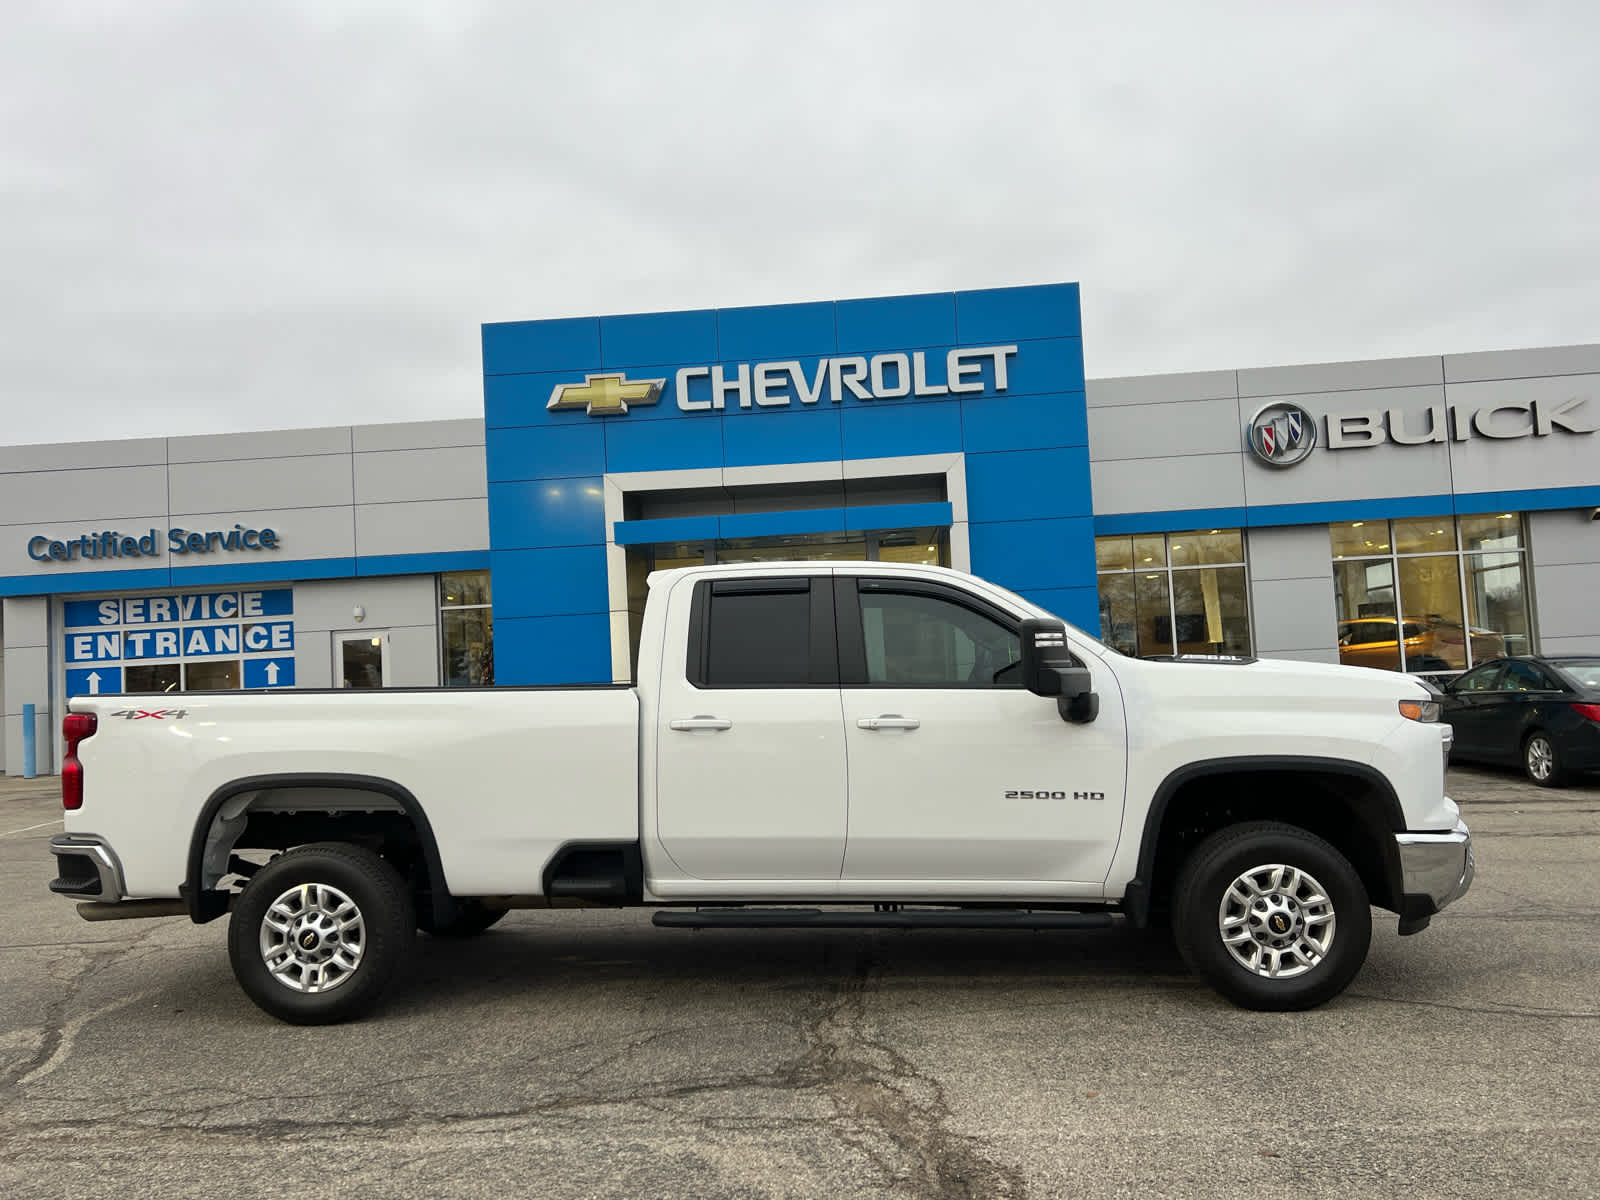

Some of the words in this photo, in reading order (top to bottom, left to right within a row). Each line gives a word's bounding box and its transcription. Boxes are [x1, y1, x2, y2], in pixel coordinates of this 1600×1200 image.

[676, 345, 1018, 411] CHEVROLET
[1325, 397, 1600, 449] BUICK
[28, 529, 156, 561] Certified
[168, 524, 277, 553] Service
[98, 592, 264, 625] SERVICE
[73, 625, 292, 660] ENTRANCE
[1005, 790, 1066, 800] 2500
[1073, 791, 1105, 801] HD
